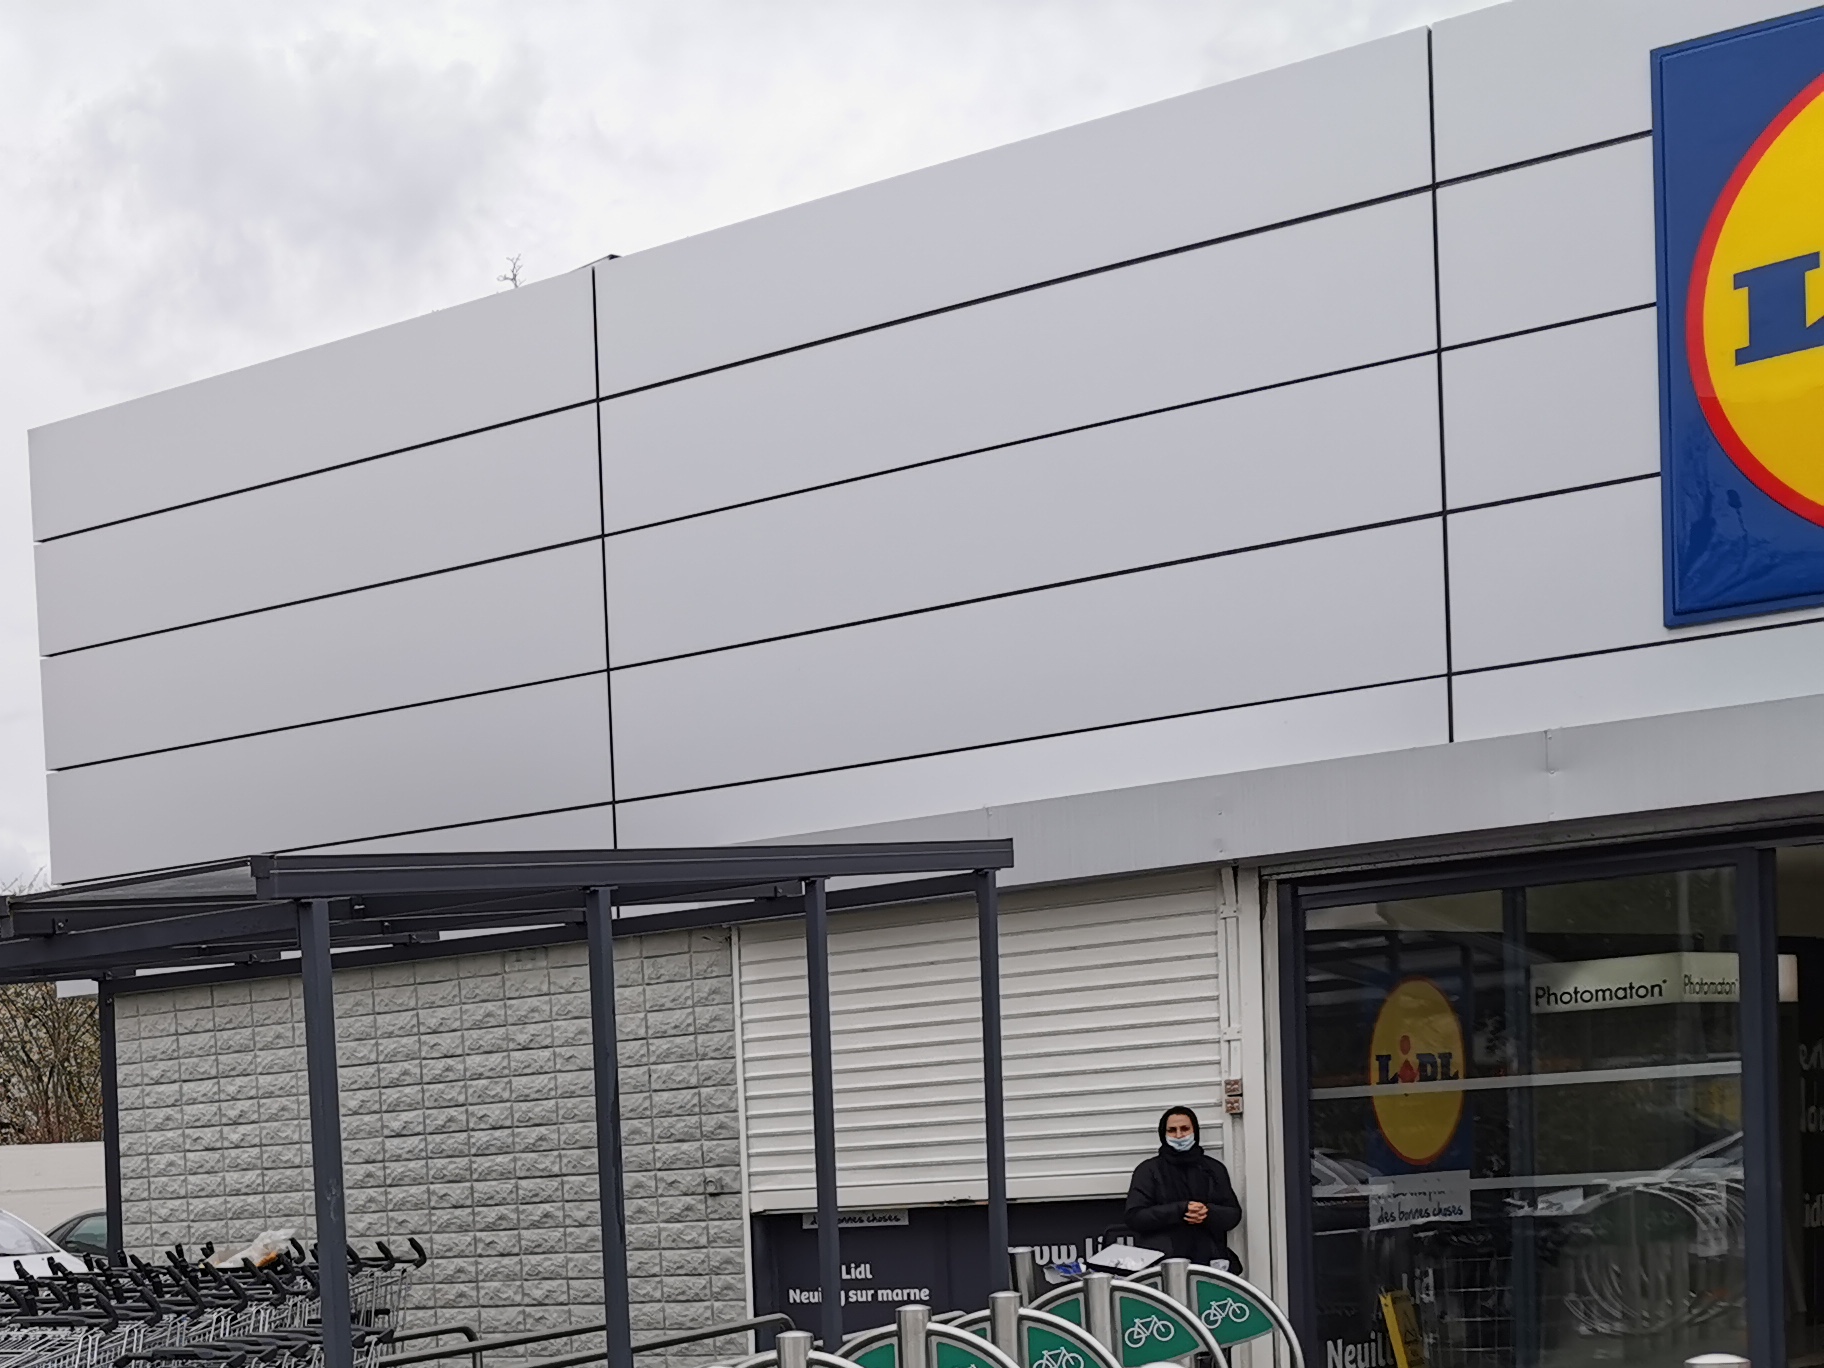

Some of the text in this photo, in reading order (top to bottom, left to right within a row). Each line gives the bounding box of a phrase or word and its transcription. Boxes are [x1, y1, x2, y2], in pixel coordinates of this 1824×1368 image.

[1535, 981, 1663, 1006] Photomaton
[1683, 974, 1737, 995] Photomaton
[841, 1263, 873, 1280] Lidl
[848, 1289, 874, 1302] sur
[877, 1287, 930, 1302] marne
